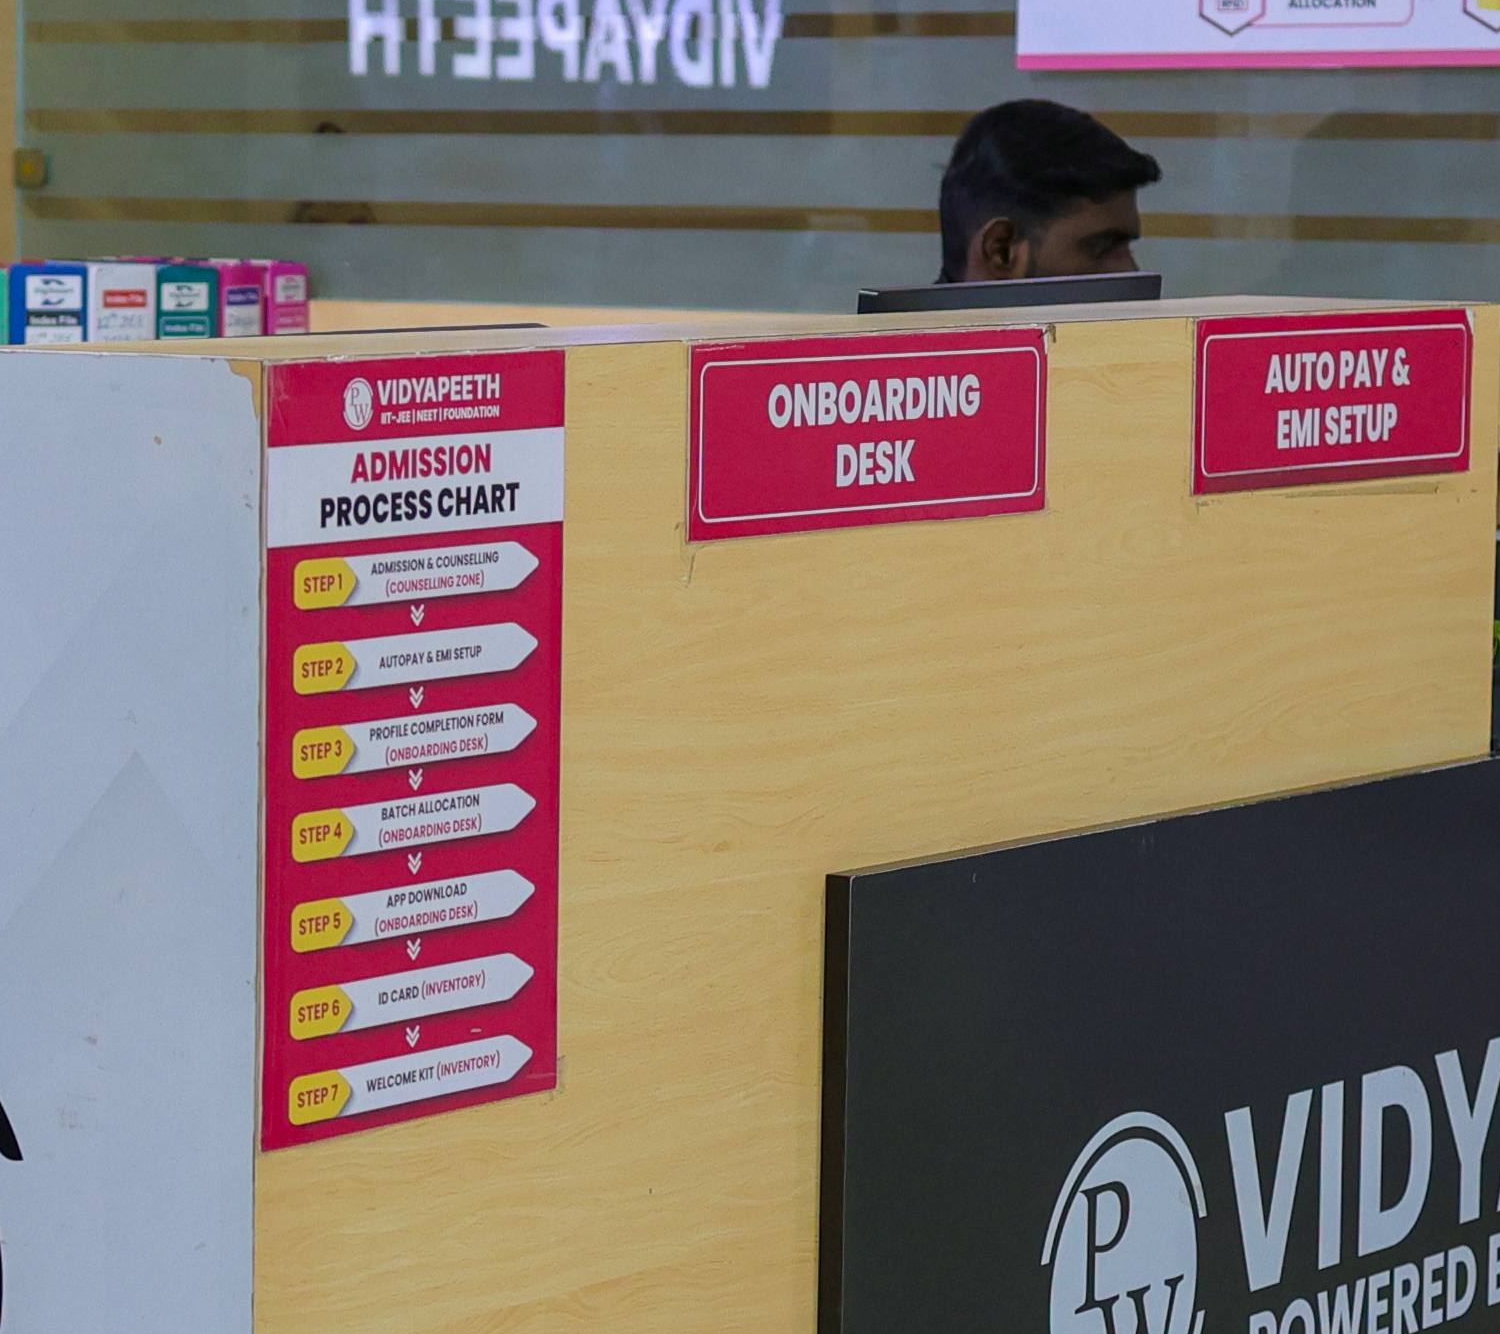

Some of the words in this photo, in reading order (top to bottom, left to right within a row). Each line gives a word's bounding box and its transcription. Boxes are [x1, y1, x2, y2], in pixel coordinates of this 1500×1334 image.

[1265, 350, 1335, 394] AUTO
[1339, 348, 1389, 387] PAY
[1391, 347, 1410, 387] &
[377, 374, 501, 406] VIDYAPEETH
[768, 373, 981, 430] ONBOARDING
[417, 408, 437, 422] NEET
[444, 404, 500, 420] FOUNDATION
[1276, 408, 1318, 450] EMI
[1324, 401, 1398, 445] SETUP
[351, 443, 492, 483] ADMISSION
[836, 440, 916, 488] DESK
[320, 488, 432, 528] PROCESS
[438, 482, 520, 517] CHART
[371, 559, 424, 575] ADMISSION
[426, 558, 433, 570] &
[435, 551, 499, 569] COUNSELLING
[303, 575, 334, 593] STEP
[337, 574, 342, 589] 1
[385, 575, 454, 598] (COUNSELLING
[456, 570, 484, 588] ZONE)
[301, 659, 333, 679] STEP
[335, 658, 343, 675] 2
[379, 652, 424, 669] AUTOPAY
[426, 651, 433, 663] &
[436, 649, 452, 662] EMI
[454, 646, 482, 661] SETUP
[370, 725, 408, 741] PROFILE
[411, 716, 474, 734] COMPLETION
[476, 712, 504, 727] FORM
[300, 744, 329, 761] STEP
[332, 741, 342, 757] 3
[381, 804, 415, 821] BATCH
[418, 793, 480, 816] ALLOCATION
[299, 827, 331, 845] STEP
[333, 825, 342, 840] 4
[386, 893, 406, 908] APP
[407, 883, 467, 905] DOWNLOAD
[299, 917, 329, 935] STEP
[333, 914, 341, 929] 5
[378, 992, 388, 1005] ID
[391, 986, 419, 1003] CARD
[421, 970, 485, 1000] (INVENTORY)
[298, 1004, 328, 1023] STEP
[332, 1001, 340, 1017] 6
[367, 1072, 417, 1092] WELCOME
[419, 1067, 433, 1082] KIT
[436, 1050, 500, 1081] (INVENTORY)
[297, 1089, 328, 1108] STEP
[331, 1085, 339, 1101] 7
